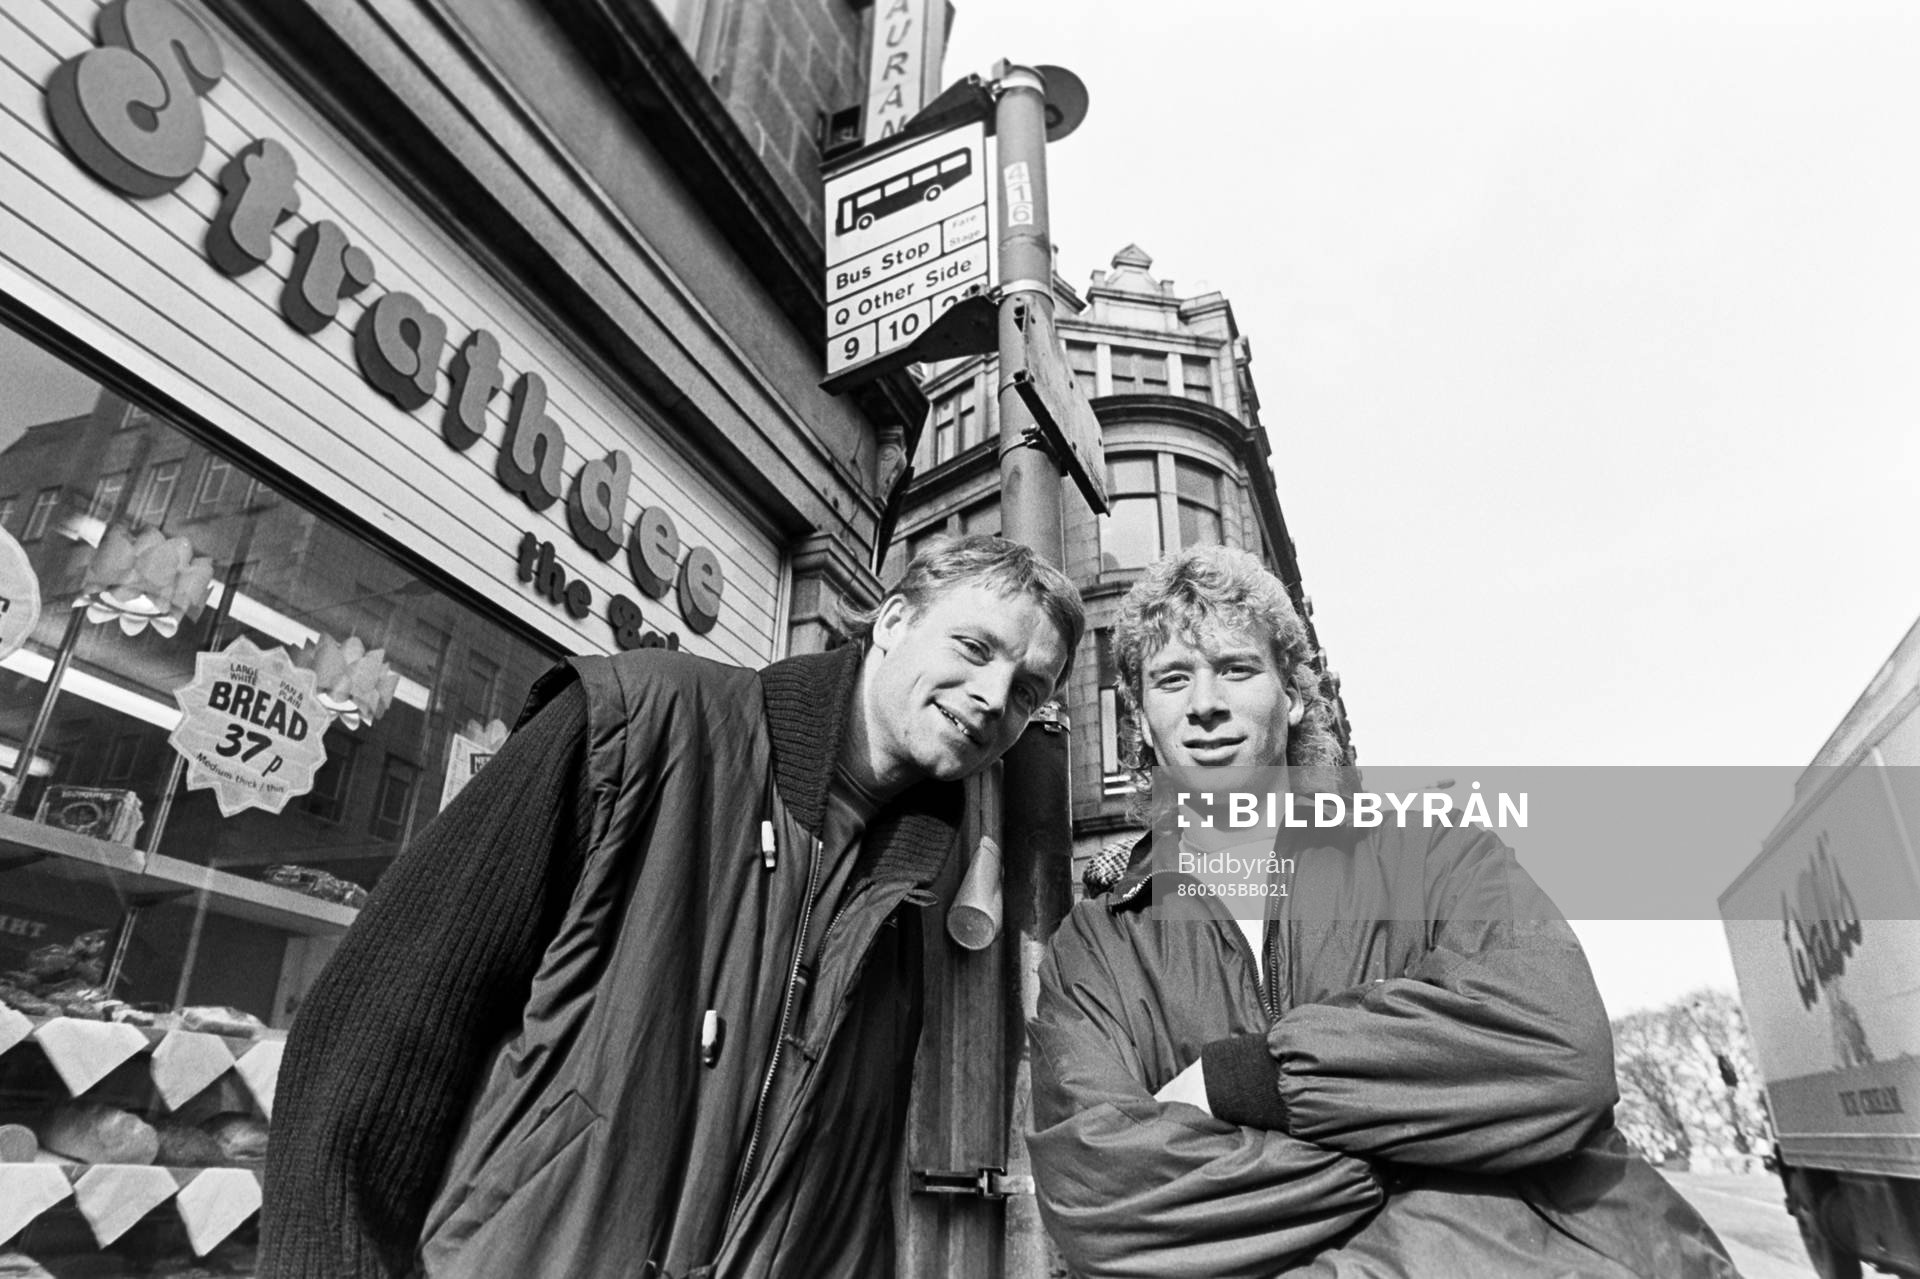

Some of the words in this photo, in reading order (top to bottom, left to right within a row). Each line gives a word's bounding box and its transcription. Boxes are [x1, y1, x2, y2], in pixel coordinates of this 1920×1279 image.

[836, 267, 872, 290] Bus
[882, 241, 930, 271] Stop
[858, 283, 914, 316] Other
[926, 258, 972, 287] Side
[45, 0, 724, 635] Strathdee
[843, 337, 860, 360] 9
[889, 313, 920, 341] 10
[518, 531, 592, 619] the
[230, 663, 259, 677] LARGE
[230, 672, 258, 686] WHITE
[208, 681, 308, 741] BREAD
[279, 690, 301, 709] PLAIN
[196, 752, 233, 780] Medium
[236, 775, 257, 788] thick
[267, 783, 284, 793] thin
